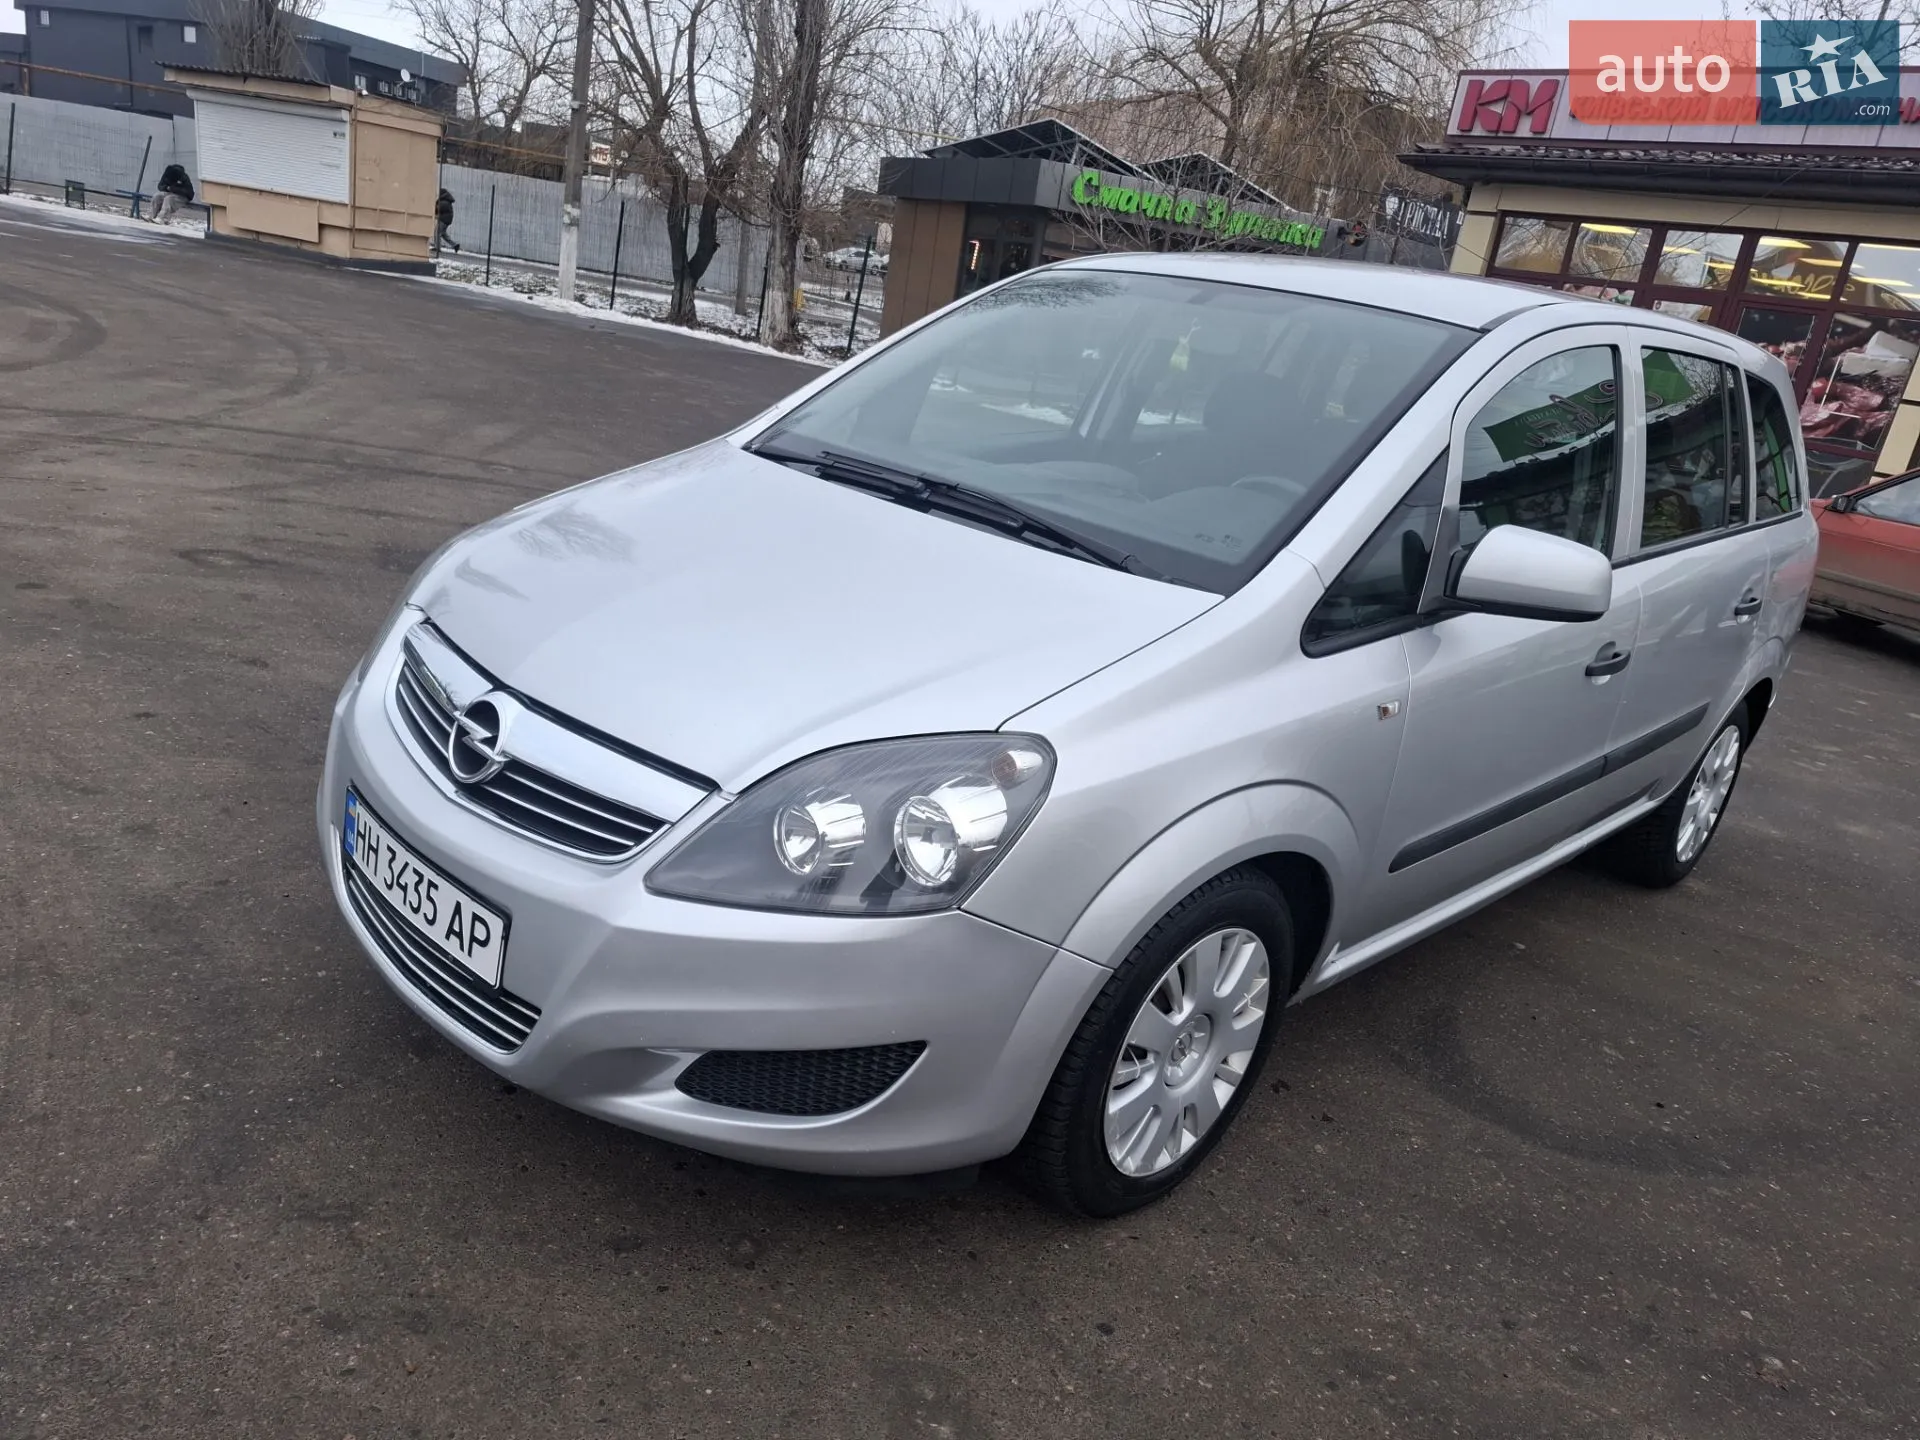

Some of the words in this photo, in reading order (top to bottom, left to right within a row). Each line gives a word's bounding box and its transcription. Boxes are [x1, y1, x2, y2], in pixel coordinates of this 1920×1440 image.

[355, 812, 380, 877] HH
[383, 844, 439, 927] 3435
[444, 900, 491, 958] AP
